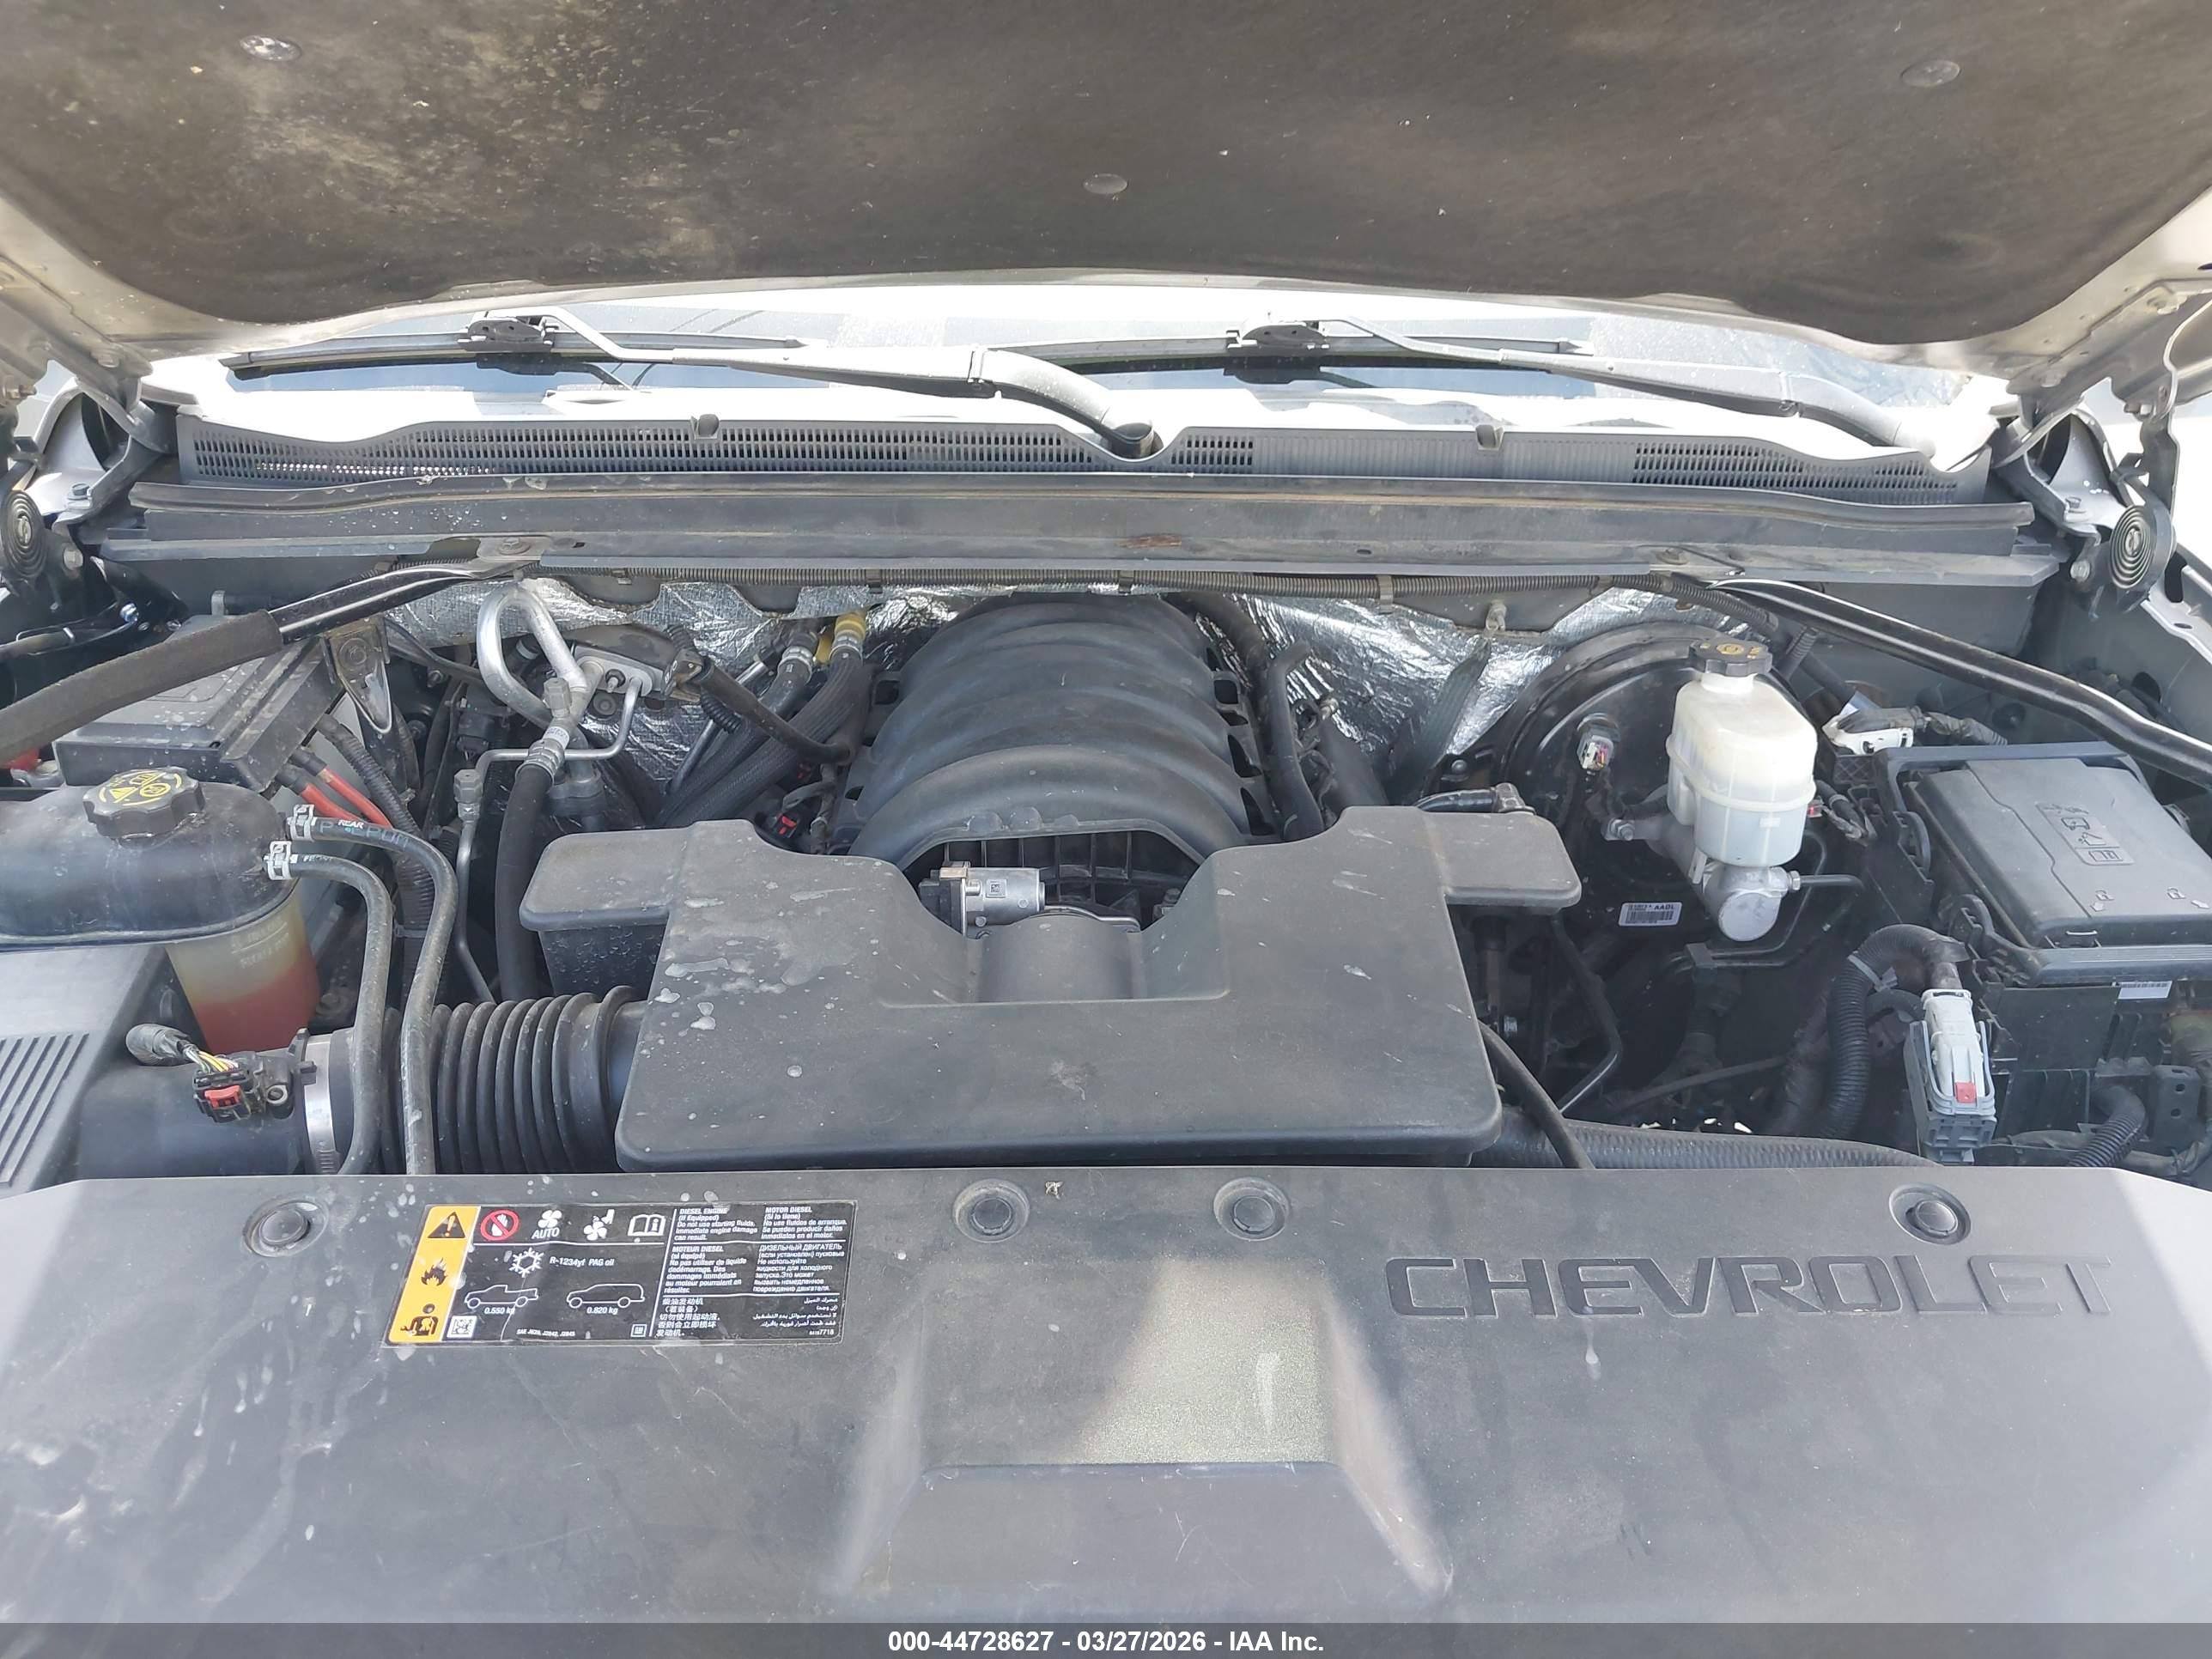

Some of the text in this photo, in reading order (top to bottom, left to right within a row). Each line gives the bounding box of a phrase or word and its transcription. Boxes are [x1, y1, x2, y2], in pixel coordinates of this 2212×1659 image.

[337, 819, 364, 829] REAR
[532, 1227, 561, 1239] AUTO
[759, 1243, 802, 1252] ДИЗЕЛЬНЫЙ
[550, 1256, 585, 1267] R-1234yf
[1385, 1255, 2112, 1319] CHEVROLET
